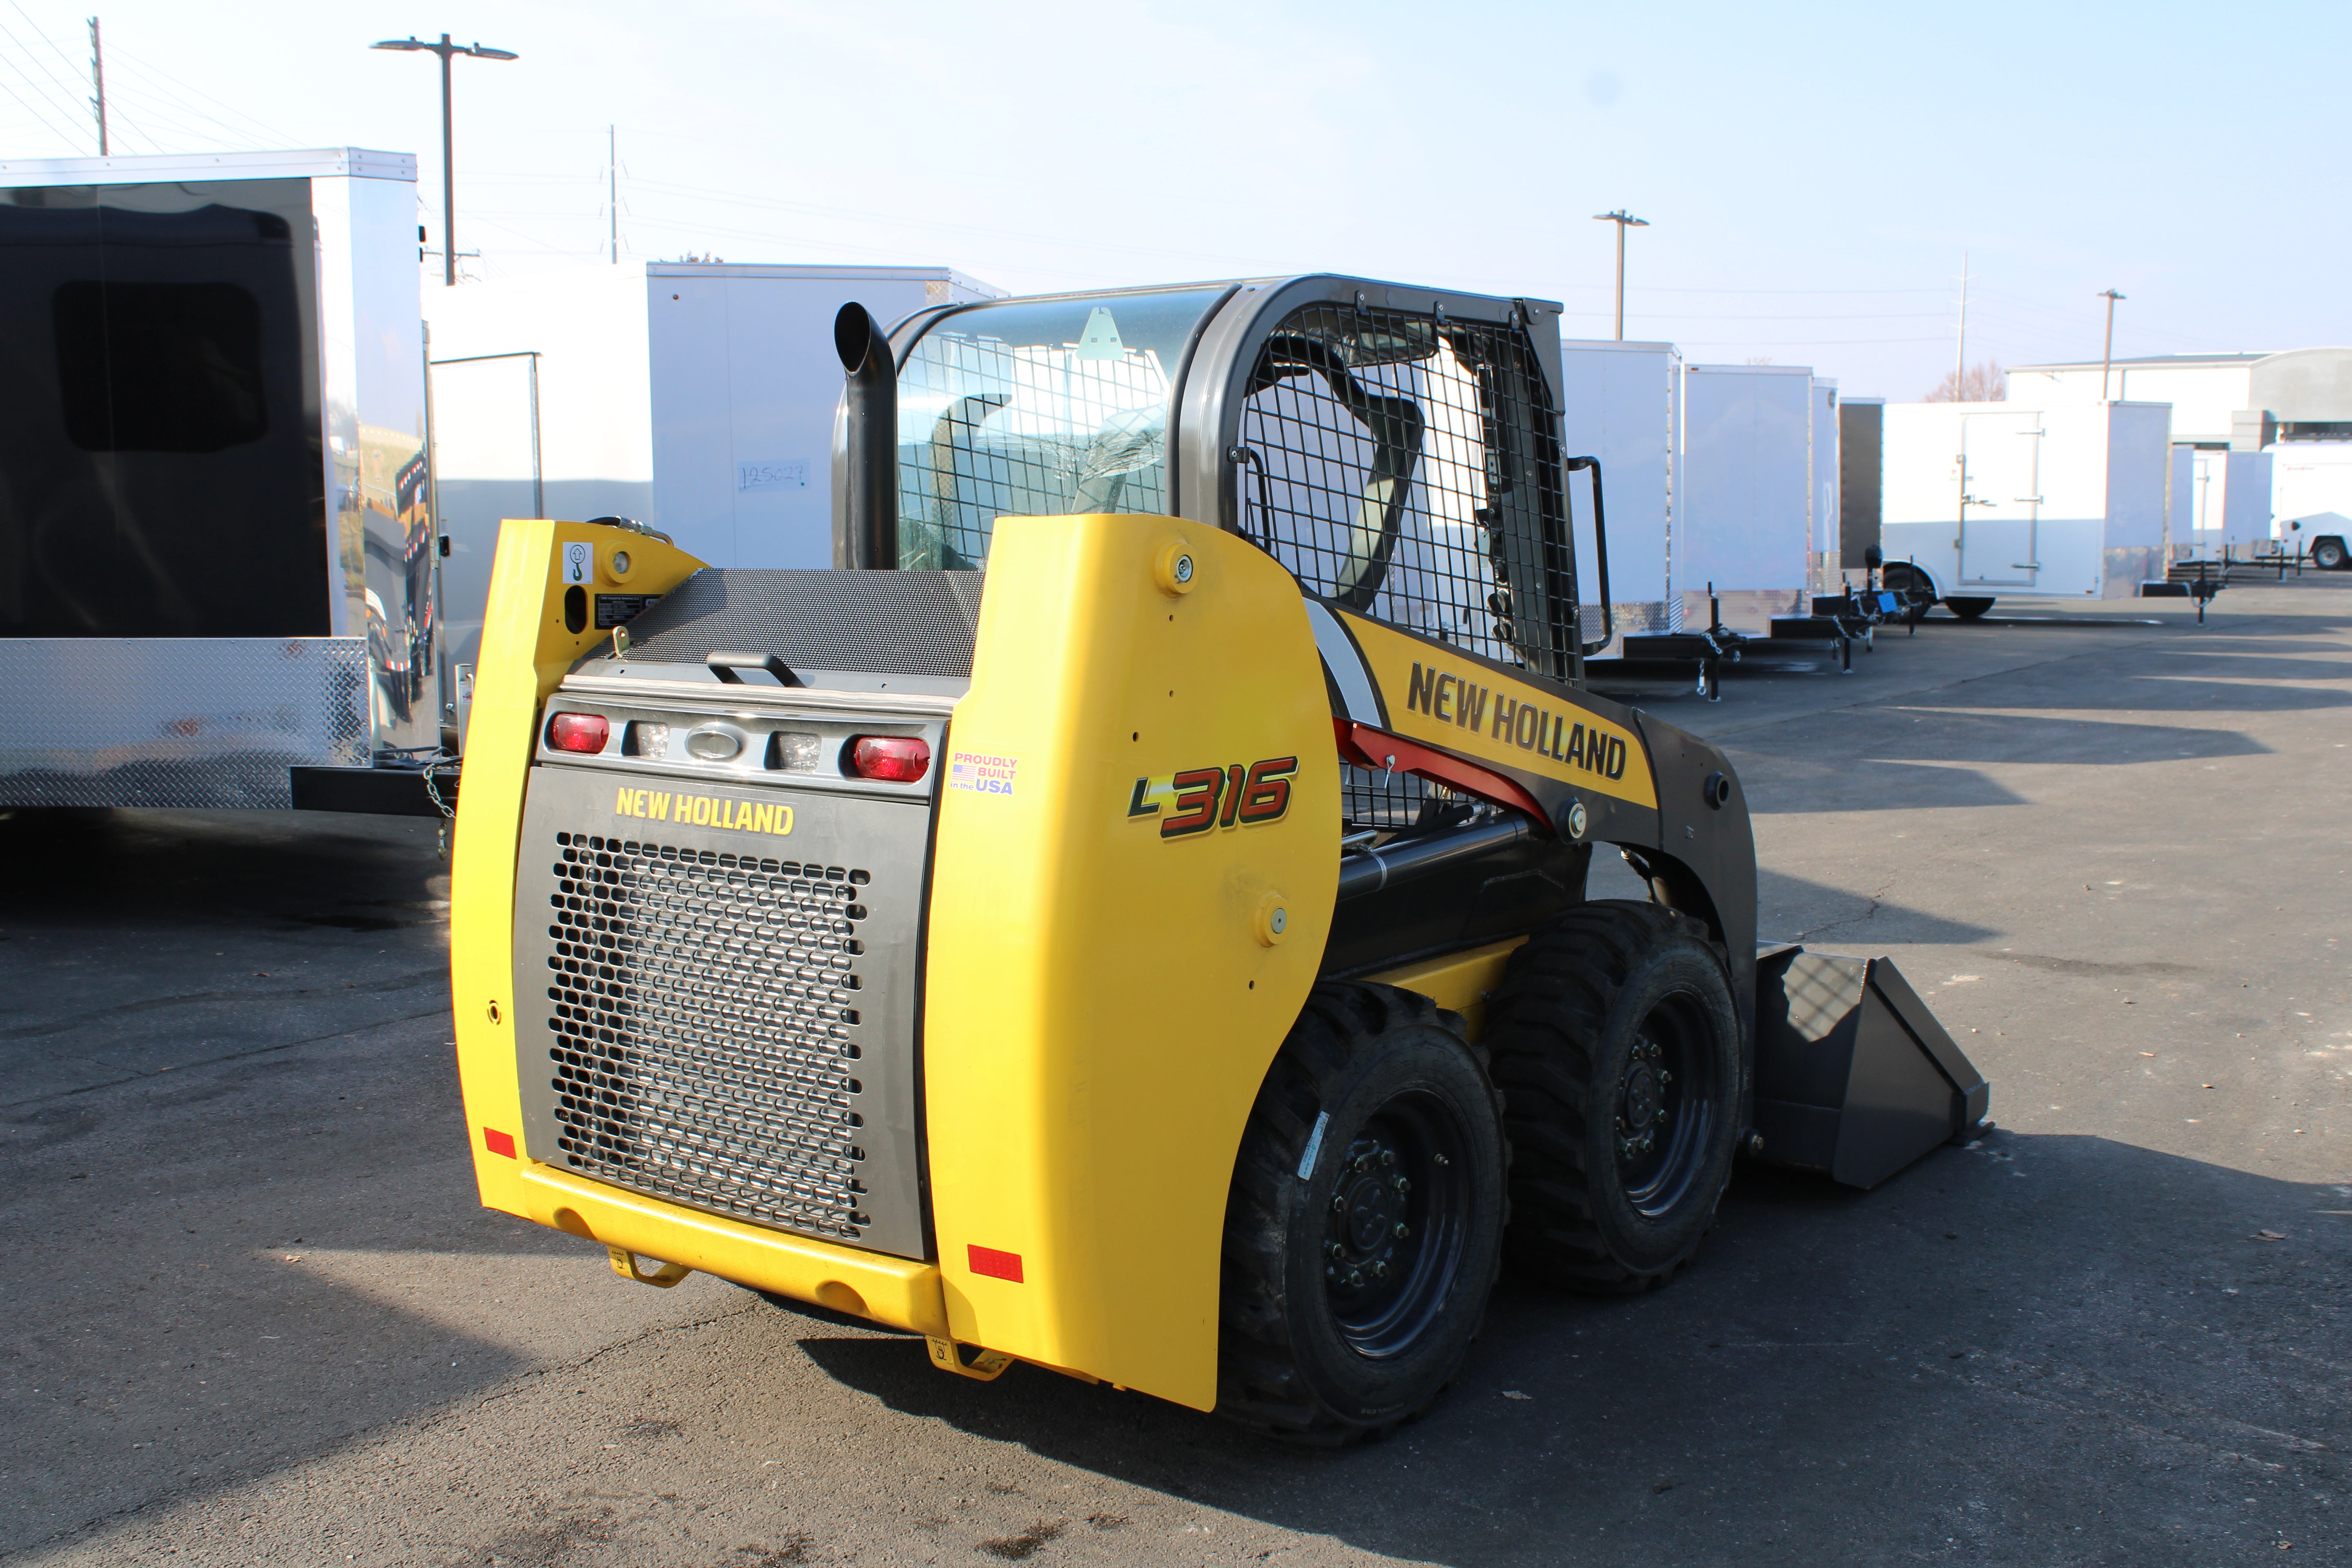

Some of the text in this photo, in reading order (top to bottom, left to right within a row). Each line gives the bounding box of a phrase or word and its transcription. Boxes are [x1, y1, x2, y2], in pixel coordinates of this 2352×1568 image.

[743, 465, 803, 489] 125027
[1407, 661, 1626, 781] NEW HOLLAND
[954, 753, 1018, 768] PROUDLY
[978, 767, 1016, 780] BUILT
[976, 779, 1013, 795] USA
[616, 787, 794, 835] NEW HOLLAND
[1303, 1149, 1314, 1176] GALAXY
